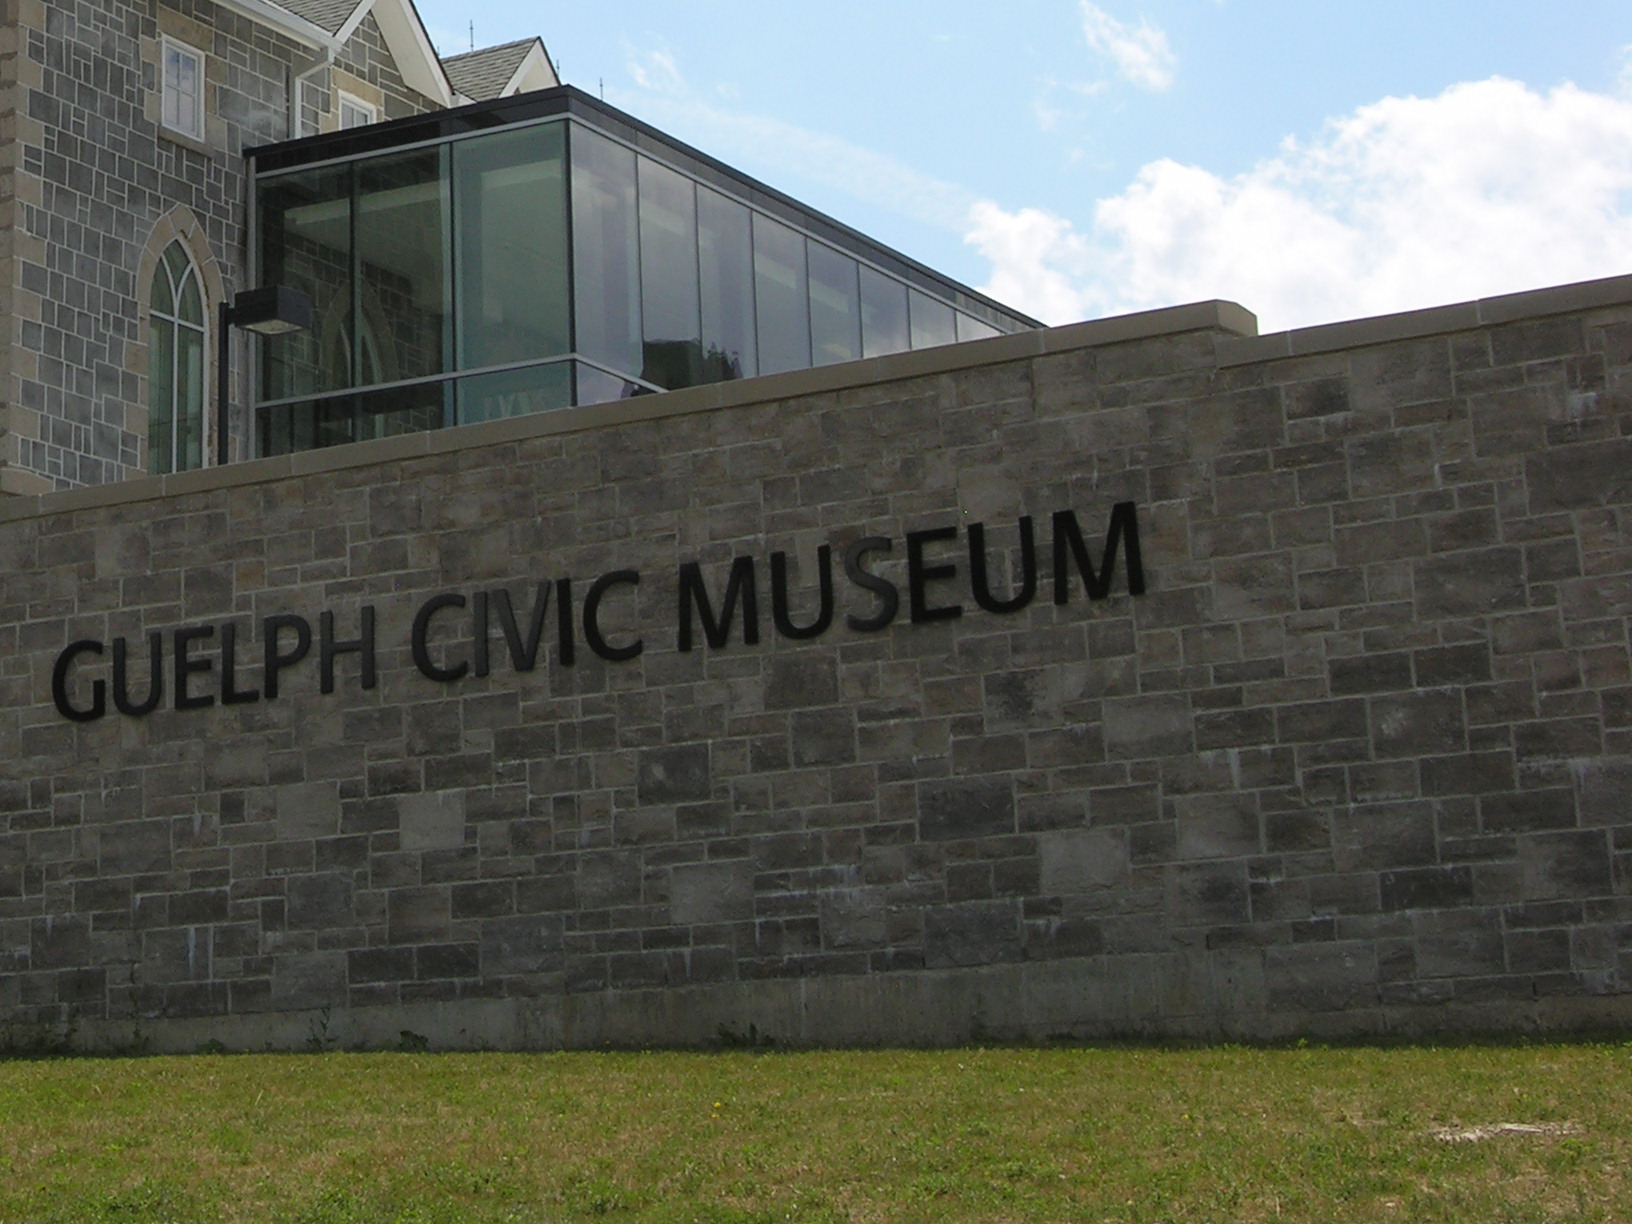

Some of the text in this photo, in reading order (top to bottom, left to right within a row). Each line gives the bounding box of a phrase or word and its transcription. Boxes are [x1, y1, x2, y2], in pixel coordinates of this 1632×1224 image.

[51, 501, 1146, 722] GUELPH CIVIC MUSEUM
